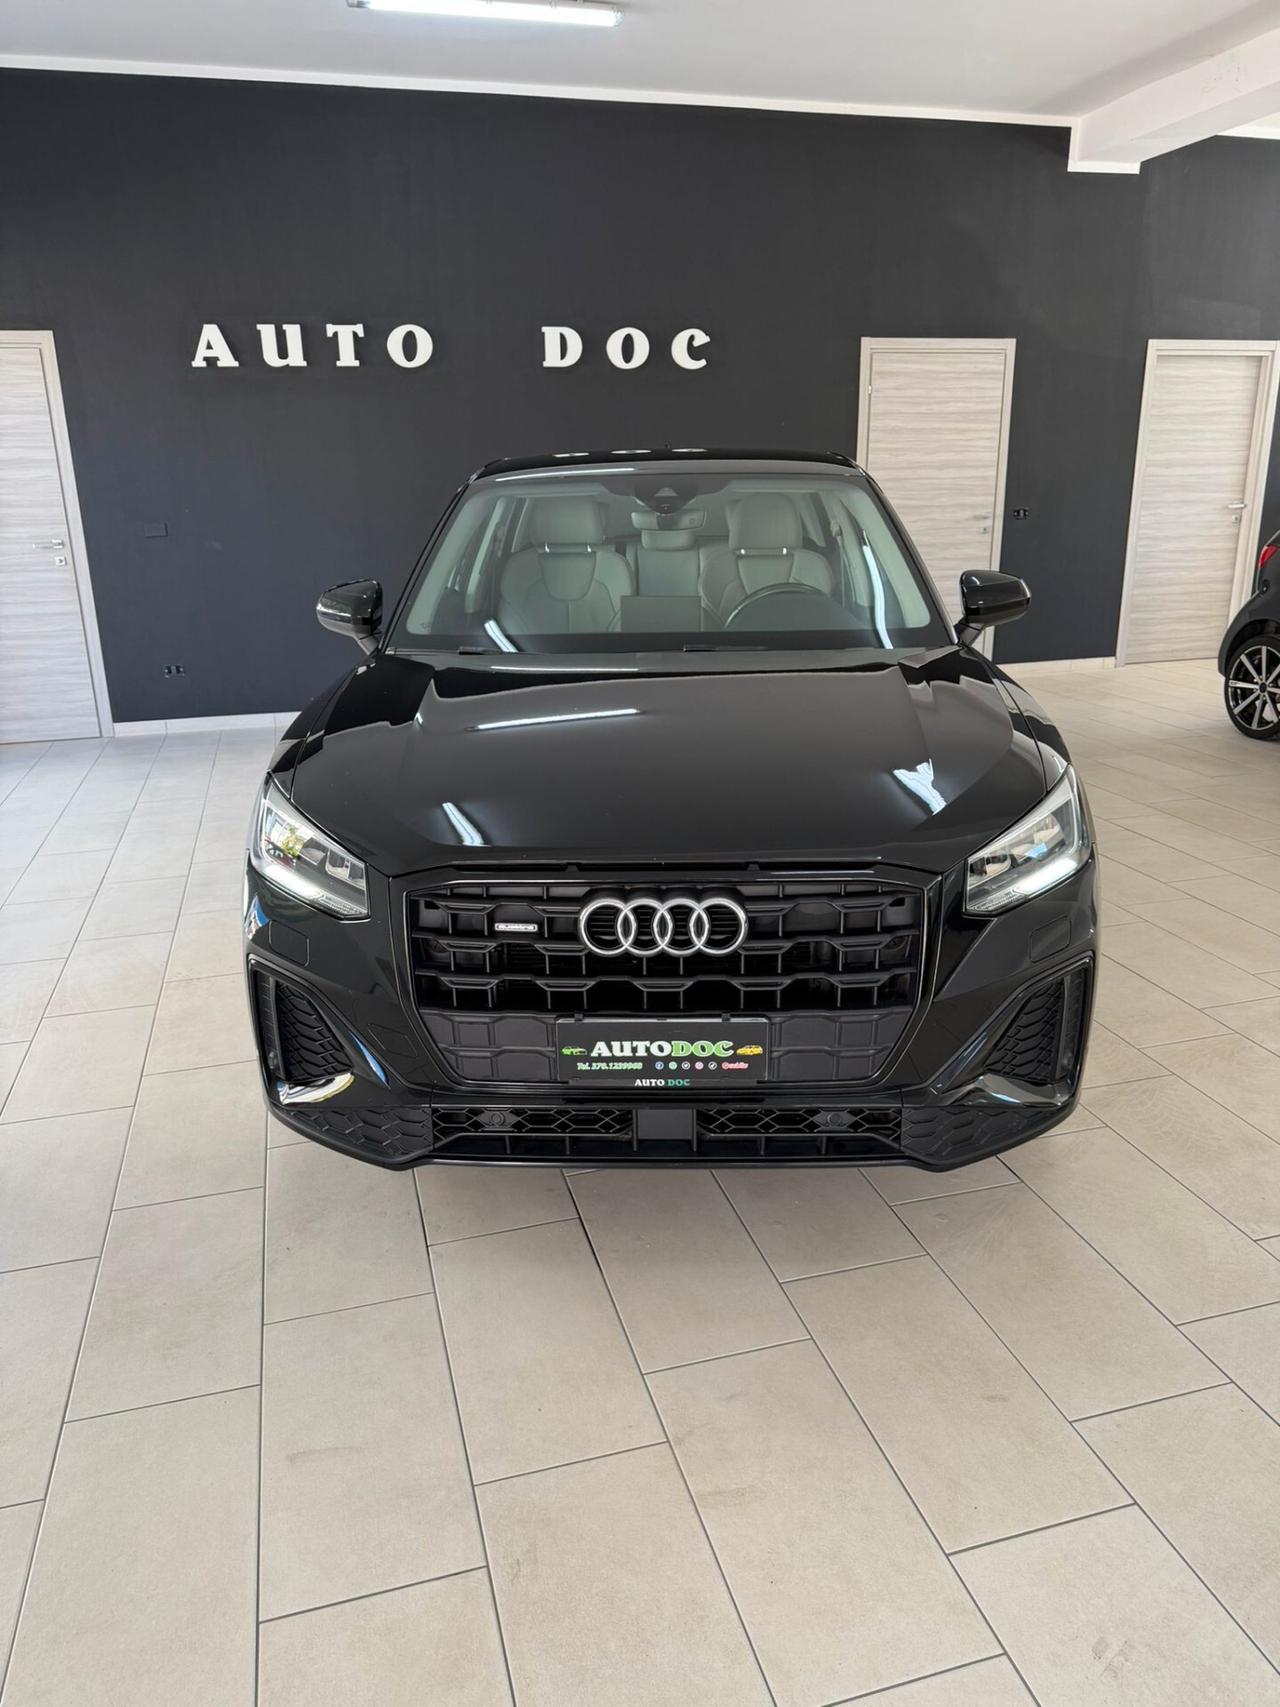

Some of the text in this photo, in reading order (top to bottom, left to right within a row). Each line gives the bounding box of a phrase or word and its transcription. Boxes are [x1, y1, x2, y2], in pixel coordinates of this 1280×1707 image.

[191, 323, 711, 370] AUTO DOC
[590, 1040, 735, 1058] AUTODOC
[634, 1078, 691, 1087] AUTO DOC
